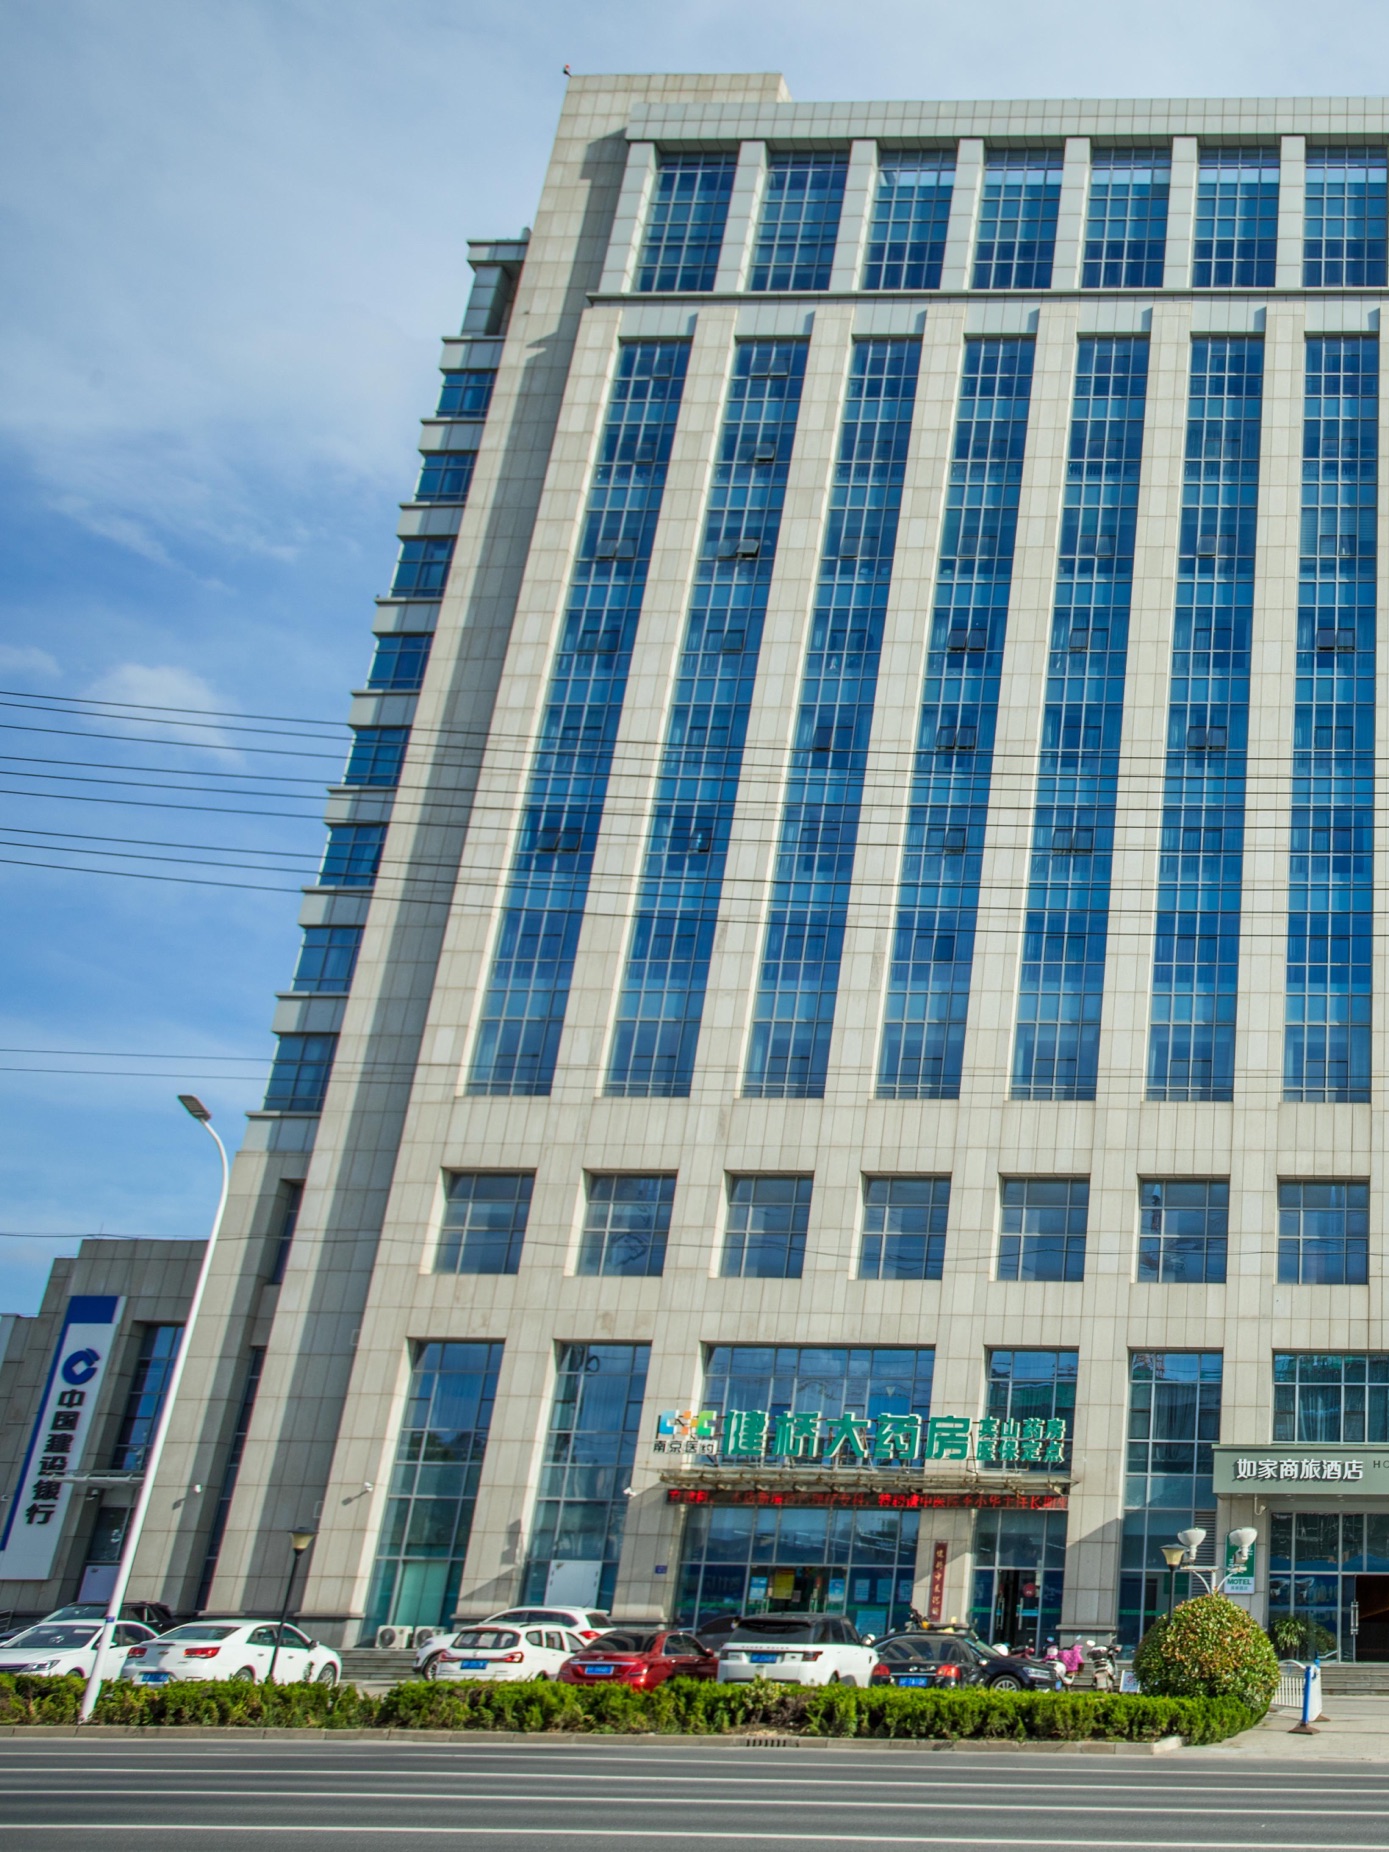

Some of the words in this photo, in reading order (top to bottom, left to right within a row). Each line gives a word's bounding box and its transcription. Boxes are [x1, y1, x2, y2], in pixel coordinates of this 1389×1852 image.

[724, 1409, 974, 1461] 健桥大药房
[25, 1388, 86, 1525] 中国建设银行
[976, 1440, 1065, 1463] 医保定点
[1235, 1458, 1365, 1481] 如家商旅酒店
[1227, 1578, 1252, 1586] MOTEL
